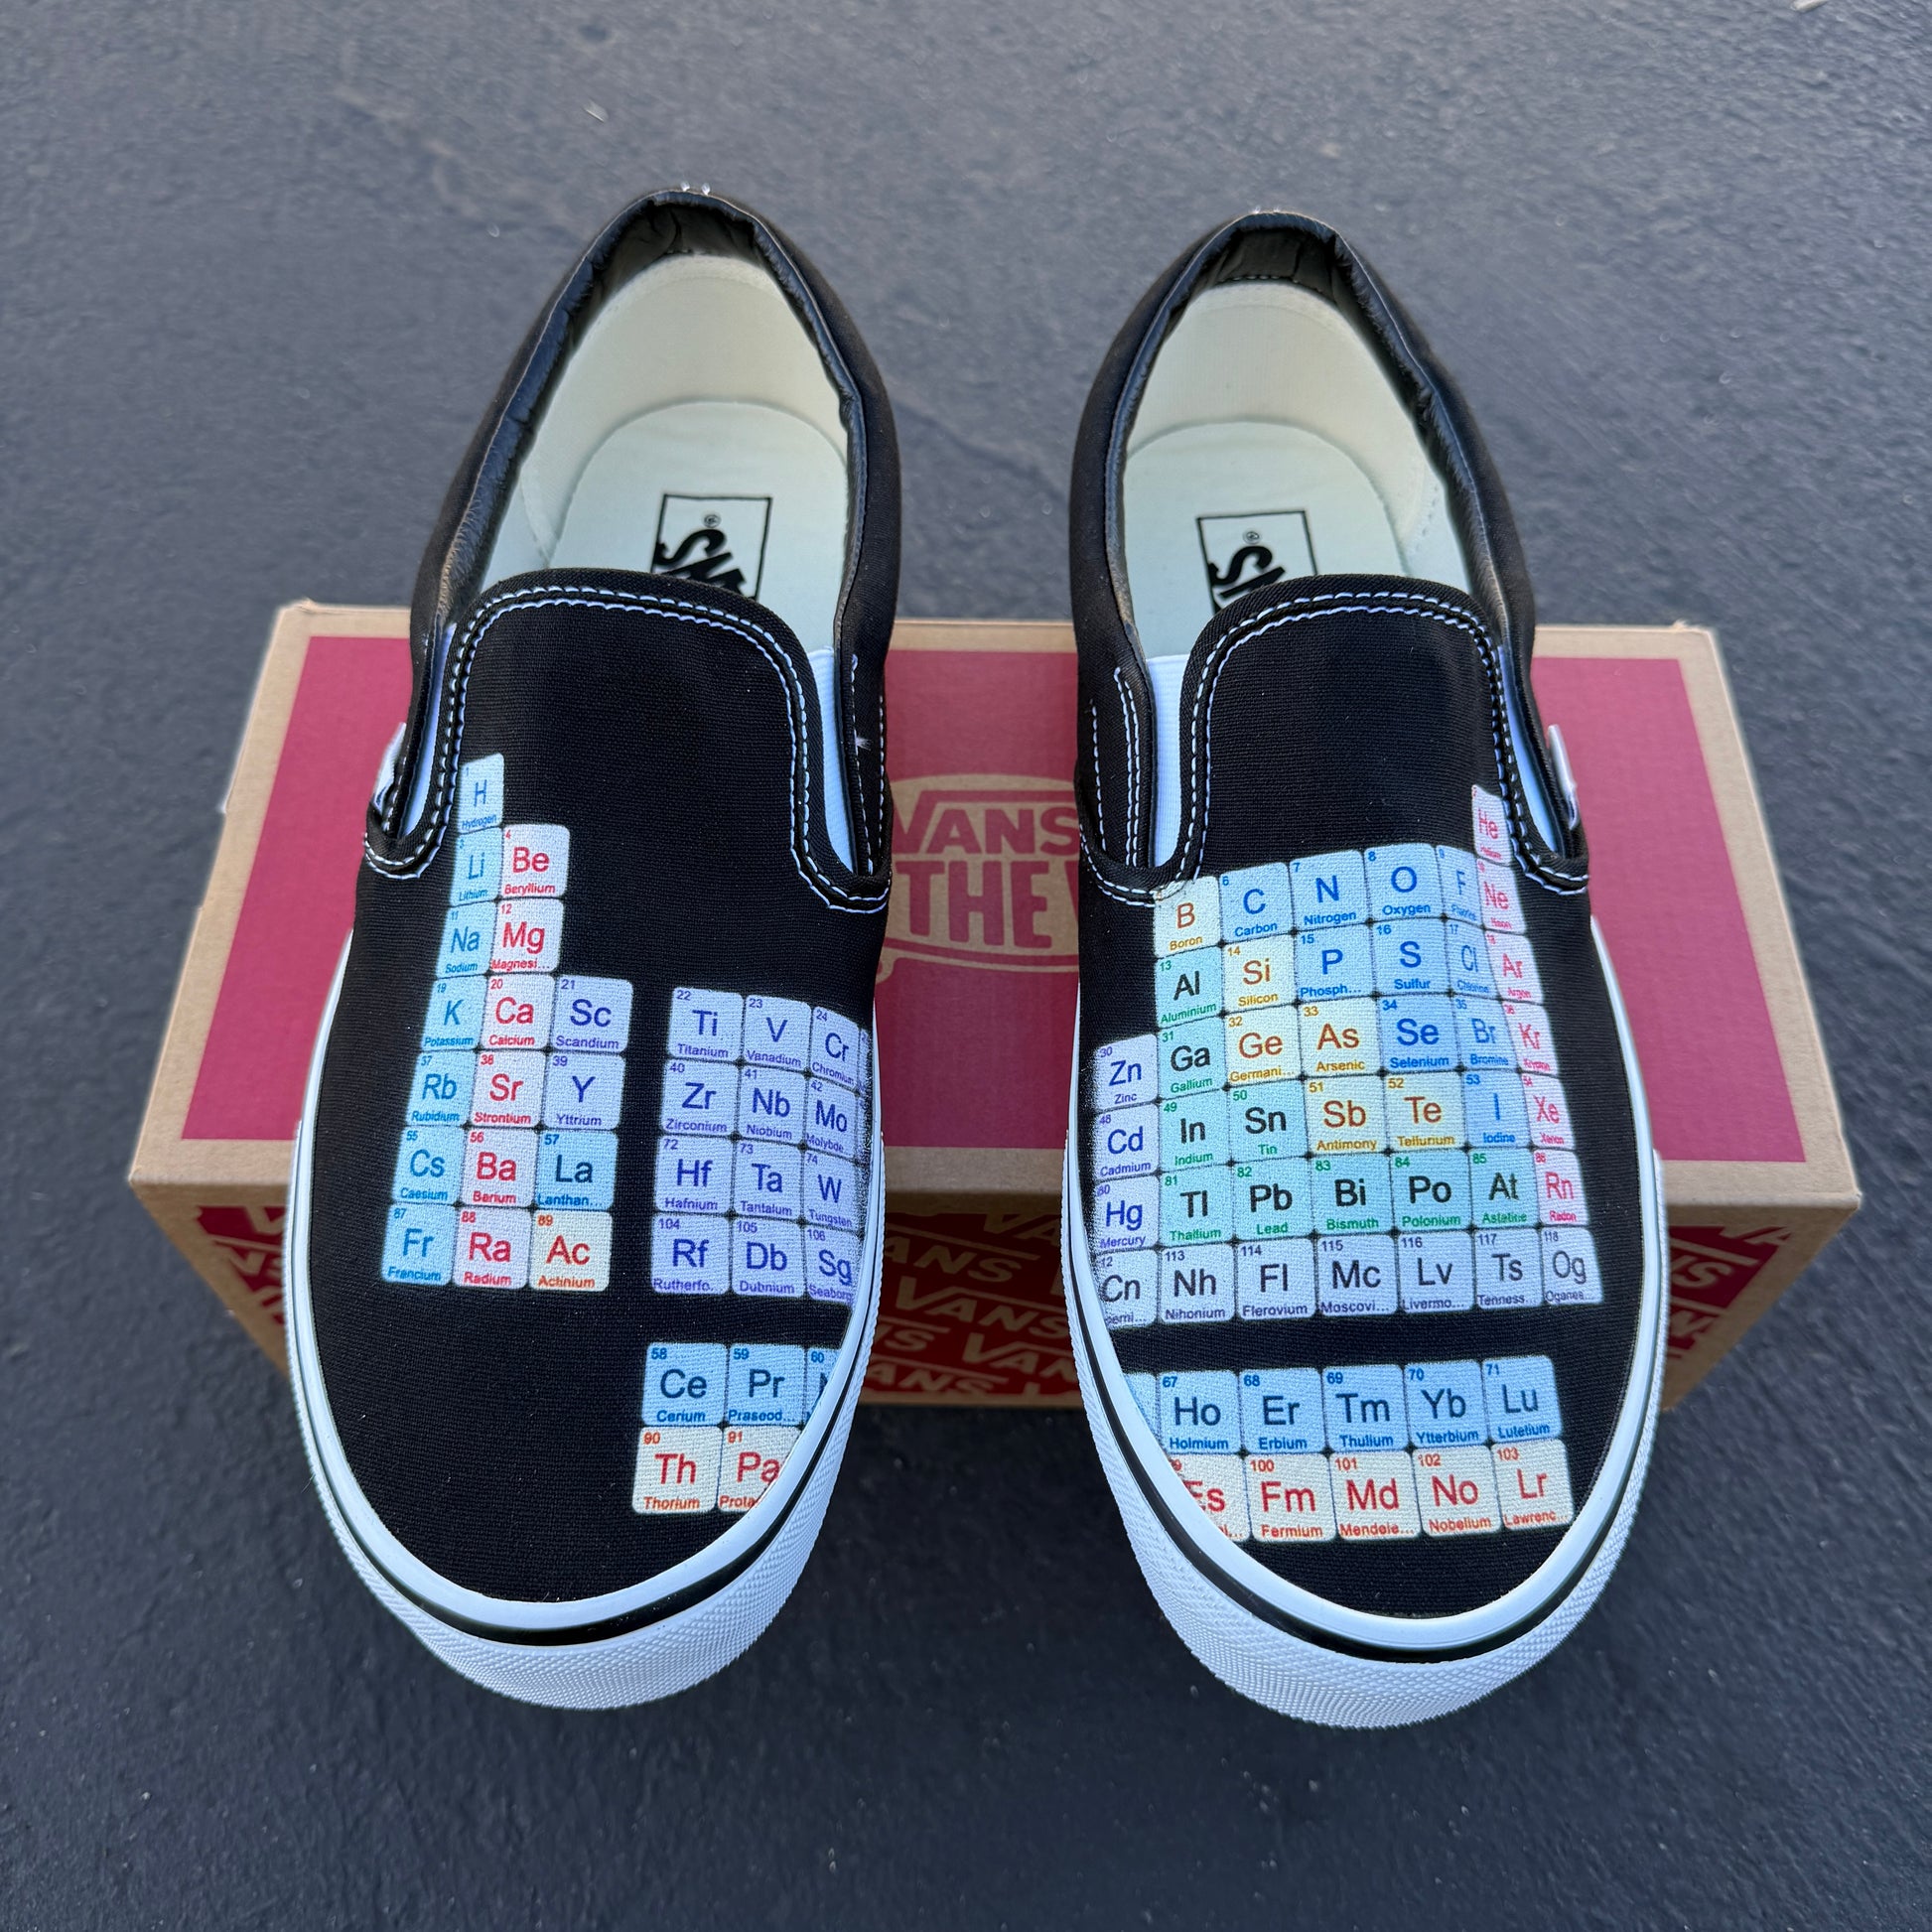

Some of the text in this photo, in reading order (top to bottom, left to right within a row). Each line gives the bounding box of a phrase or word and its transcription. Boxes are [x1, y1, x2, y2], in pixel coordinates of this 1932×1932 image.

[475, 780, 486, 806] H
[892, 790, 1079, 856] VANS
[512, 847, 549, 873] Be
[504, 884, 555, 897] Beryllium
[1315, 875, 1339, 902] N
[1391, 866, 1417, 893] O
[896, 861, 1051, 948] THE
[1243, 889, 1266, 914] C
[1382, 904, 1431, 917] Oxygen
[1176, 902, 1195, 928] B
[1304, 910, 1356, 927] Nitrogen
[451, 927, 480, 953] Na
[502, 922, 544, 954] Mg
[1170, 935, 1203, 950] Boron
[1235, 922, 1278, 937] Carbon
[1321, 949, 1343, 975] P
[1400, 941, 1422, 968] S
[1461, 945, 1478, 972] Cl
[1243, 958, 1270, 985] Si
[1394, 979, 1431, 990] Sulfur
[561, 980, 575, 990] 21
[677, 991, 690, 1000] 22
[1173, 971, 1200, 1001] Al
[444, 1000, 464, 1025] K
[496, 997, 534, 1024] Ca
[570, 999, 612, 1027] Sc
[1238, 993, 1278, 1007] Silicon
[692, 1011, 718, 1035] Ti
[1161, 1003, 1216, 1024] Aluminium
[489, 1035, 535, 1045] Calcium
[556, 1035, 619, 1048] Scandium
[766, 1018, 787, 1042] V
[1316, 1024, 1359, 1050] As
[1397, 1018, 1440, 1046] Se
[1471, 1019, 1496, 1044] Br
[678, 1043, 728, 1057] Titanium
[825, 1033, 849, 1061] Cr
[1171, 1045, 1210, 1071] Ga
[1238, 1032, 1283, 1058] Ge
[553, 1056, 567, 1066] 39
[747, 1050, 801, 1067] Vanadium
[1316, 1059, 1365, 1072] Arsenic
[1390, 1055, 1449, 1068] Selenium
[1109, 1060, 1142, 1086] Zn
[1171, 1076, 1213, 1093] Gallium
[422, 1074, 457, 1100] Rb
[489, 1074, 523, 1101] Sr
[572, 1076, 595, 1102] Y
[682, 1082, 716, 1109] Zr
[1114, 1093, 1137, 1104] Zinc
[1233, 1090, 1247, 1100] 50
[753, 1088, 790, 1117] Nb
[1323, 1100, 1366, 1128] Sb
[1404, 1096, 1442, 1124] Te
[1533, 1095, 1560, 1124] Xe
[412, 1111, 460, 1122] Rubidium
[475, 1112, 531, 1123] Strontium
[556, 1114, 601, 1126] Yttrium
[665, 1119, 728, 1132] Zirconium
[816, 1100, 847, 1132] Mo
[1245, 1107, 1286, 1134] Sn
[1108, 1126, 1143, 1154] Cd
[1181, 1118, 1205, 1144] In
[1397, 1135, 1455, 1147] Tellurium
[1483, 1132, 1516, 1144] Iodine
[1258, 1144, 1277, 1155] Tin
[1316, 1139, 1377, 1151] Antimony
[410, 1150, 445, 1177] Cs
[477, 1152, 516, 1180] Ba
[556, 1155, 593, 1182] La
[1100, 1161, 1152, 1176] Cadmium
[1175, 1152, 1213, 1166] Indium
[1315, 1160, 1330, 1171] 83
[677, 1160, 713, 1187] Hf
[752, 1164, 782, 1191] Ta
[1489, 1173, 1518, 1200] At
[1545, 1172, 1574, 1199] Rn
[400, 1187, 448, 1200] Caesium
[474, 1191, 516, 1203] Barium
[818, 1174, 841, 1203] W
[1250, 1183, 1292, 1212] Pb
[1334, 1178, 1366, 1206] Bi
[1408, 1175, 1451, 1203] Po
[665, 1198, 718, 1210] Hafnium
[741, 1201, 792, 1216] Tantalum
[1106, 1200, 1143, 1231] Hg
[1179, 1190, 1208, 1217] Tl
[1257, 1222, 1289, 1235] Lead
[1326, 1218, 1379, 1230] Bismuth
[1402, 1216, 1460, 1226] Polonium
[403, 1229, 435, 1257] Fr
[469, 1233, 511, 1262] Ra
[1171, 1228, 1221, 1241] Thallium
[1401, 1237, 1423, 1248] 116
[546, 1236, 591, 1265] Ac
[672, 1239, 709, 1267] Rf
[747, 1242, 787, 1270] Db
[388, 1267, 441, 1281] Francium
[464, 1273, 511, 1286] Radium
[819, 1249, 852, 1286] Sg
[1260, 1264, 1288, 1293] Fl
[1332, 1260, 1381, 1289] Mc
[1417, 1258, 1452, 1286] Lv
[1492, 1253, 1523, 1282] Ts
[1552, 1250, 1587, 1285] Og
[538, 1276, 595, 1288] Actinium
[740, 1280, 794, 1294] Dubnium
[1102, 1275, 1141, 1303] Cn
[1173, 1269, 1216, 1297] Nh
[896, 1276, 1070, 1338] VANS
[1166, 1308, 1225, 1320] Nihonium
[1243, 1304, 1308, 1316] Flerovium
[651, 1347, 667, 1359] 58
[660, 1369, 707, 1398] Ce
[749, 1369, 784, 1397] Pr
[1244, 1375, 1260, 1386] 68
[1409, 1369, 1424, 1381] 70
[1174, 1397, 1221, 1426] Ho
[1263, 1395, 1300, 1426] Er
[1336, 1393, 1390, 1423] Tm
[1422, 1388, 1465, 1419] Yb
[1501, 1384, 1538, 1413] Lu
[657, 1410, 706, 1422] Cerium
[1170, 1438, 1228, 1449] Holmium
[1259, 1438, 1308, 1449] Erbium
[1340, 1435, 1393, 1447] Thulium
[1417, 1431, 1478, 1445] Ytterbium
[1498, 1425, 1550, 1439] Lutetium
[655, 1452, 695, 1484] Th
[737, 1451, 780, 1483] Pa
[1250, 1459, 1275, 1472] 100
[1261, 1481, 1315, 1512] Fm
[1346, 1477, 1399, 1510] Md
[1431, 1474, 1478, 1506] No
[1517, 1468, 1548, 1499] Lr
[644, 1497, 700, 1509] Thorium
[1262, 1525, 1322, 1538] Fermium
[1429, 1518, 1491, 1532] Nobelium
